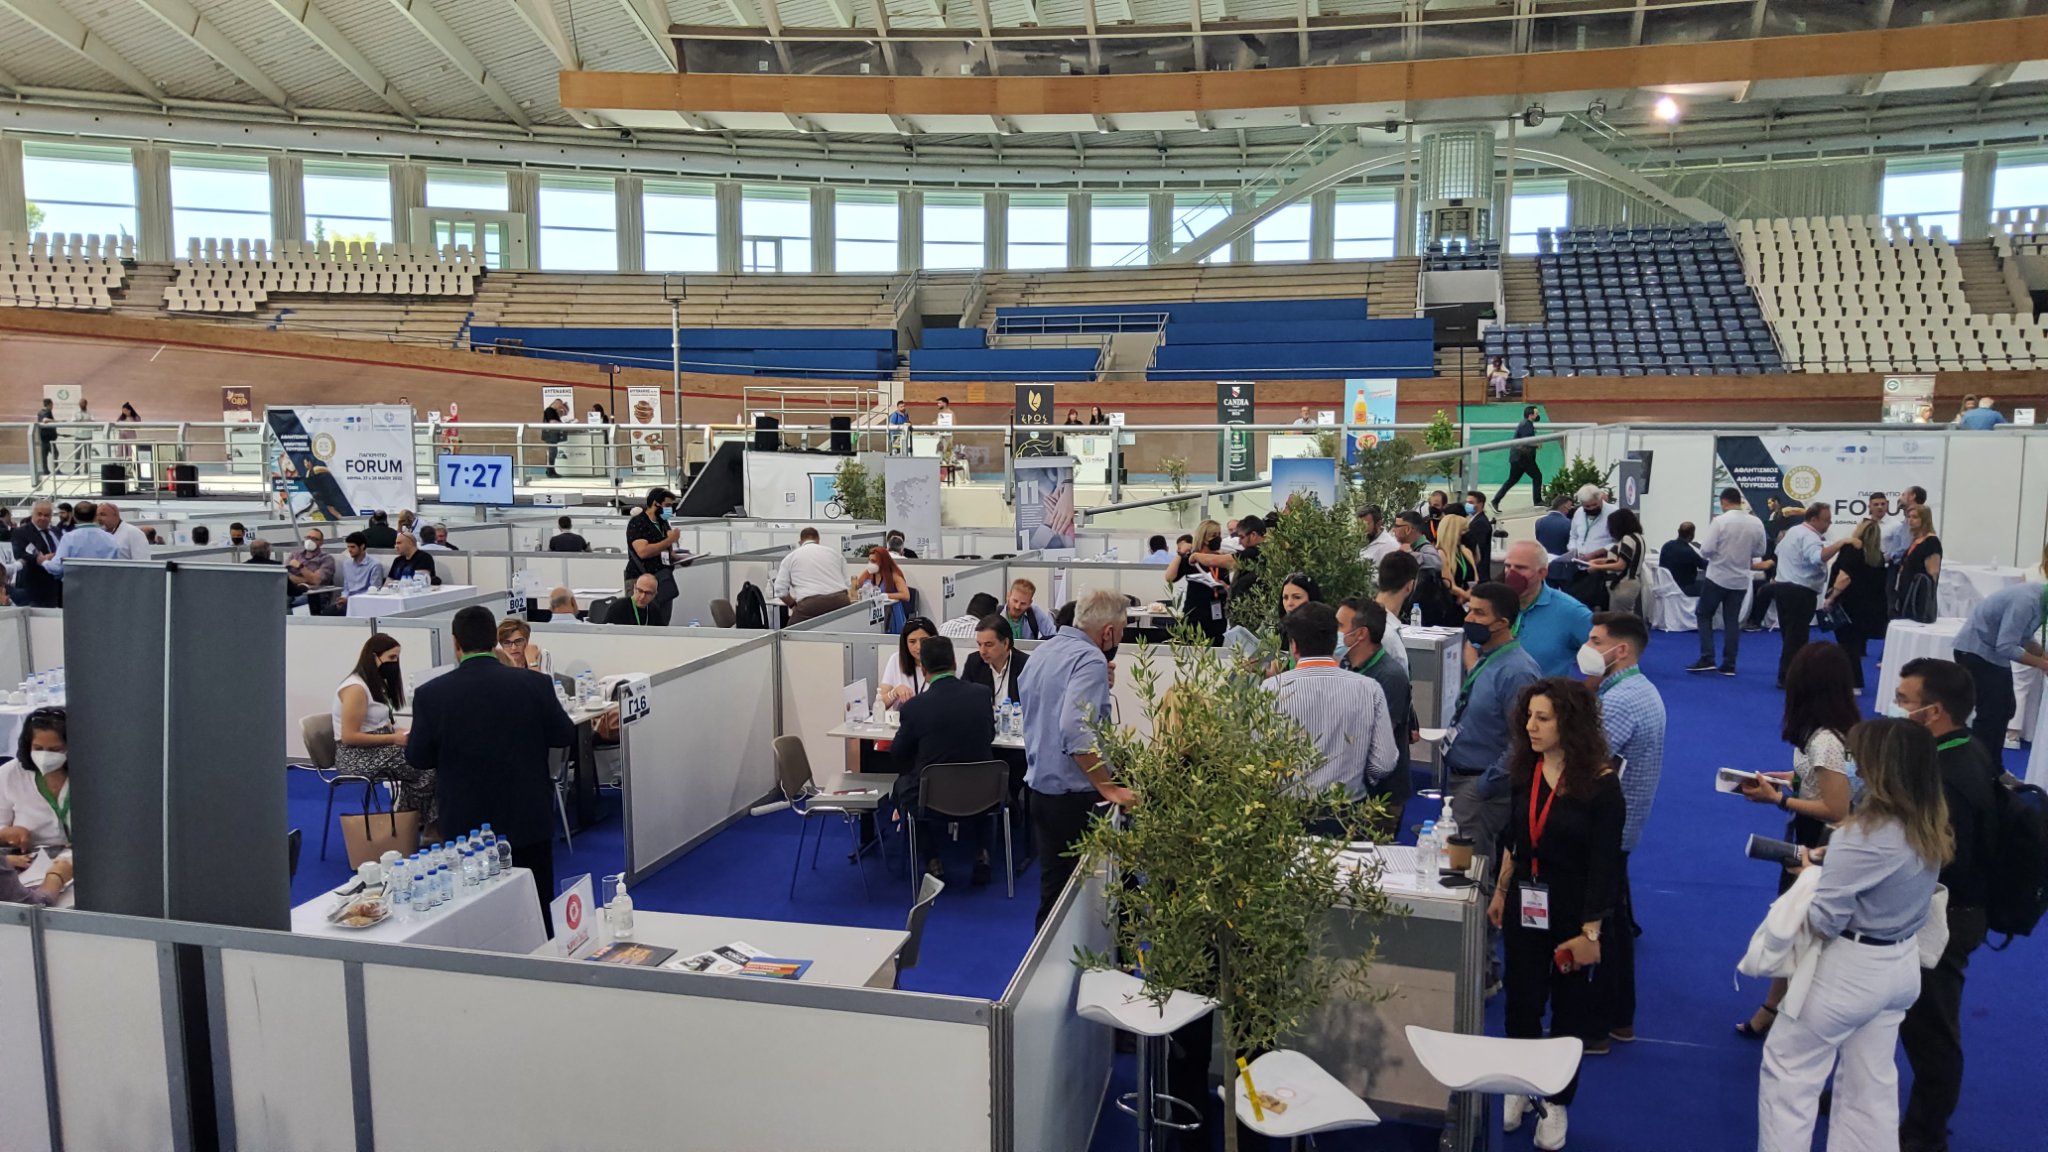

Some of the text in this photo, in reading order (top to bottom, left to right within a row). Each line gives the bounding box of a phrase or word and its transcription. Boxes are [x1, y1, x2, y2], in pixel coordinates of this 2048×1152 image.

[1223, 398, 1249, 406] CANDIA
[345, 459, 403, 473] FORUM
[447, 463, 502, 488] 7:27
[546, 495, 553, 504] 3
[1018, 479, 1039, 505] 11
[628, 695, 647, 715] Γ16
